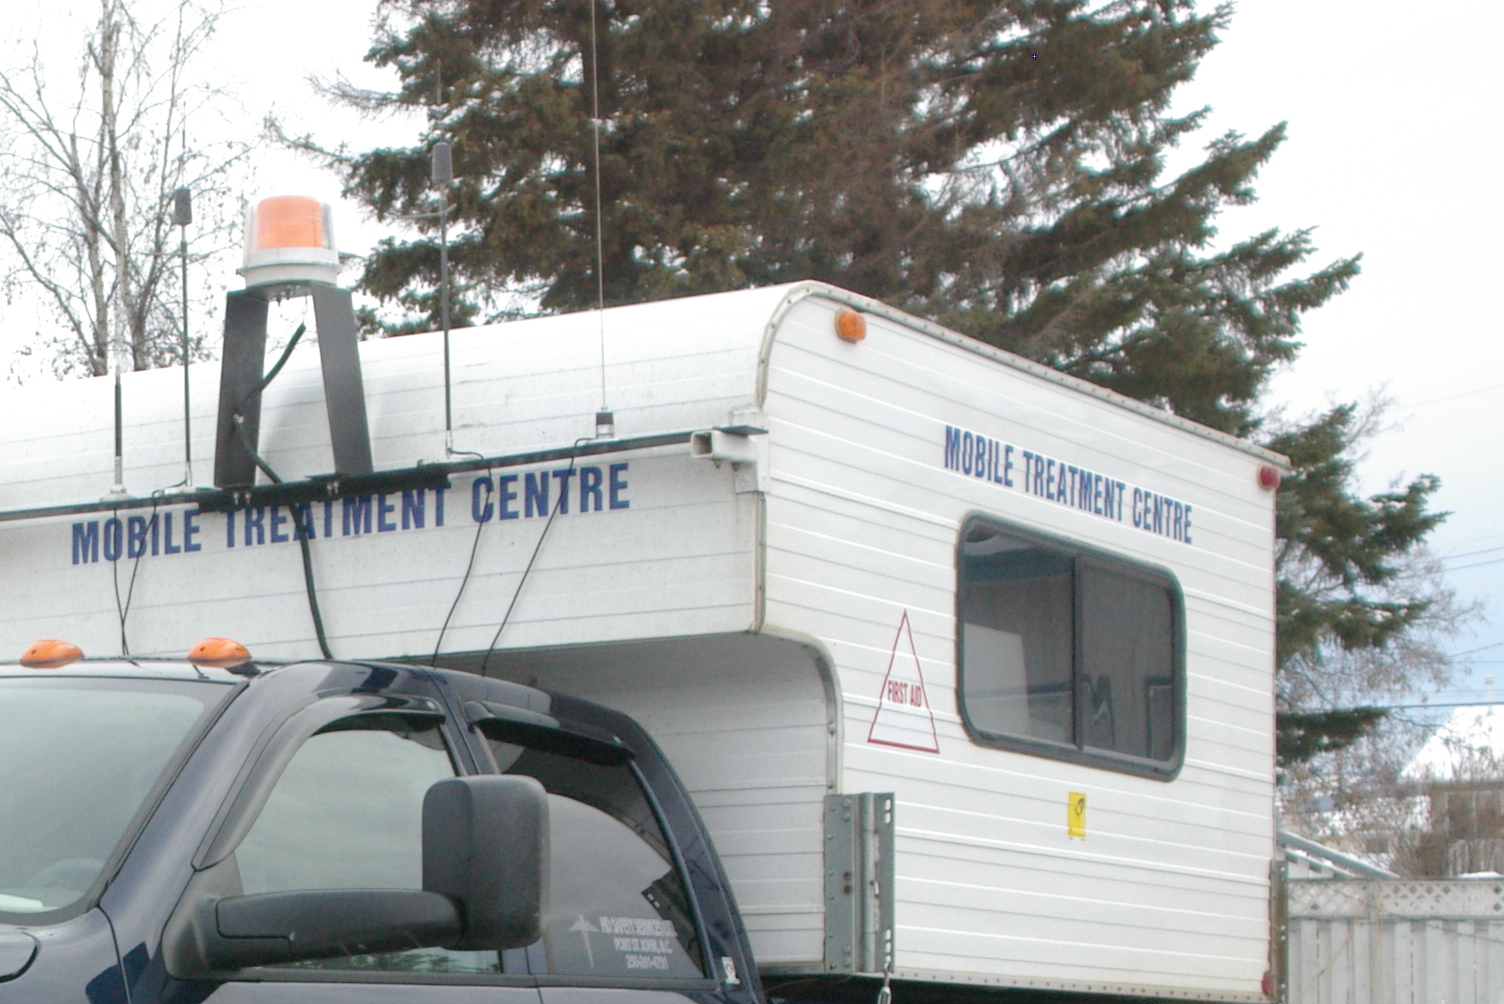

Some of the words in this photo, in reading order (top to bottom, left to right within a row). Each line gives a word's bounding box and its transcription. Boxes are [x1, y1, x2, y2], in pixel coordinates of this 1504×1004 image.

[72, 509, 201, 564] MOBILE
[472, 463, 630, 523] CENTRE
[944, 425, 1013, 487] MOBILE
[1023, 451, 1126, 521] TREATMENT
[1133, 487, 1192, 544] CENTRE
[888, 680, 907, 704] FIRST
[910, 684, 921, 707] AID
